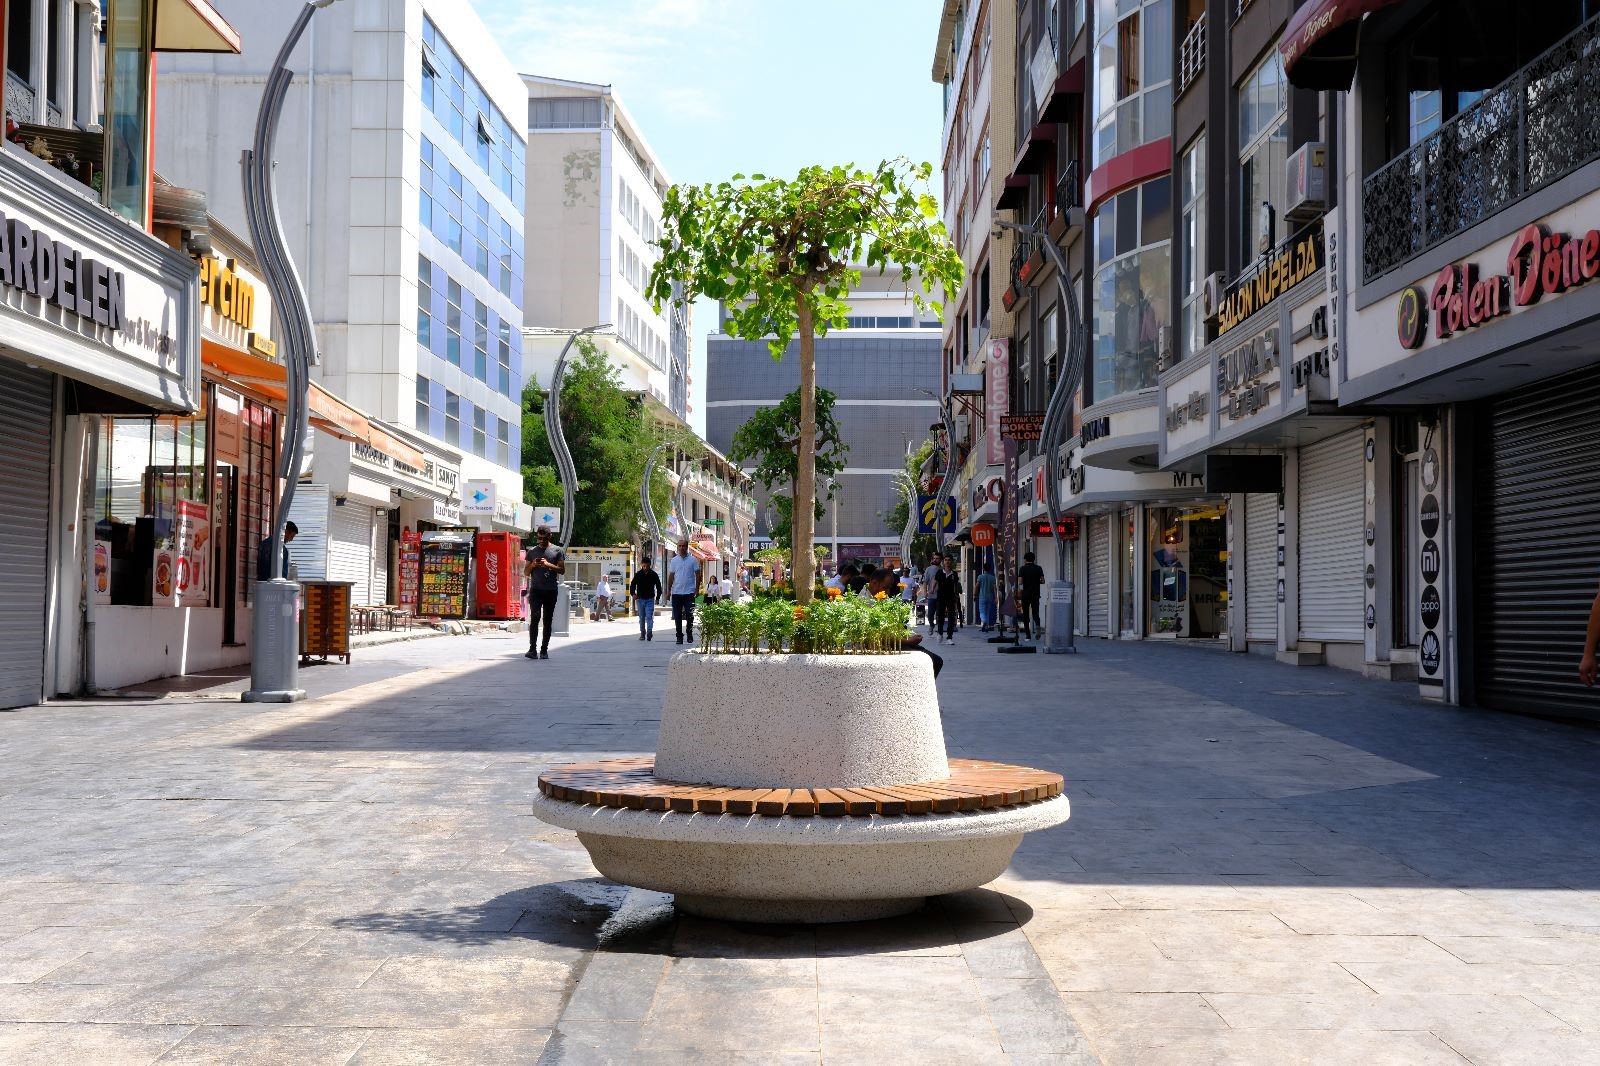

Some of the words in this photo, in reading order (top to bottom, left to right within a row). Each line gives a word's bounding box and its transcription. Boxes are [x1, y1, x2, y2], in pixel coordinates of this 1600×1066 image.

[1218, 279, 1252, 336] SALON
[1255, 234, 1317, 310] NUPELDA
[1431, 263, 1509, 338] Polen
